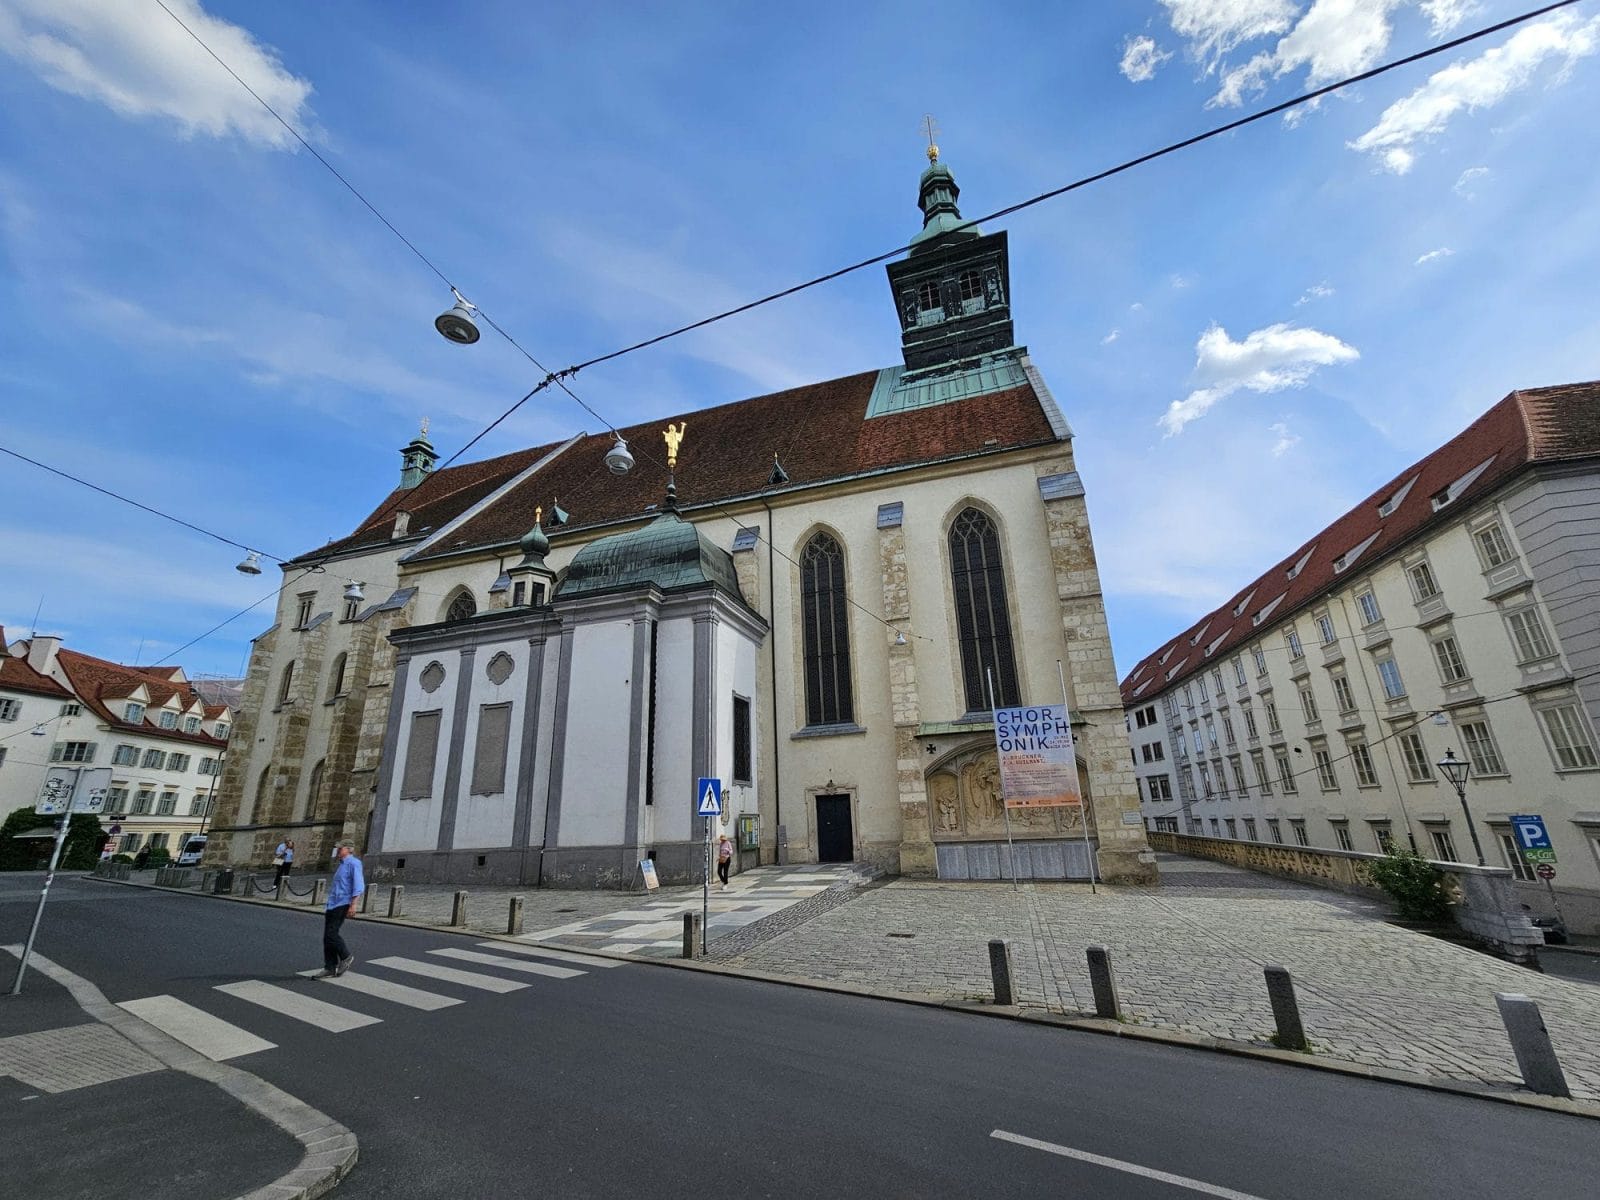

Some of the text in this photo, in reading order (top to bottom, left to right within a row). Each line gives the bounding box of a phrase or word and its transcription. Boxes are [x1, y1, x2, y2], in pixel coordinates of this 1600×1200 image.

[999, 721, 1068, 738] SYMPH
[1001, 738, 1049, 752] ONIK
[1519, 824, 1542, 847] P
